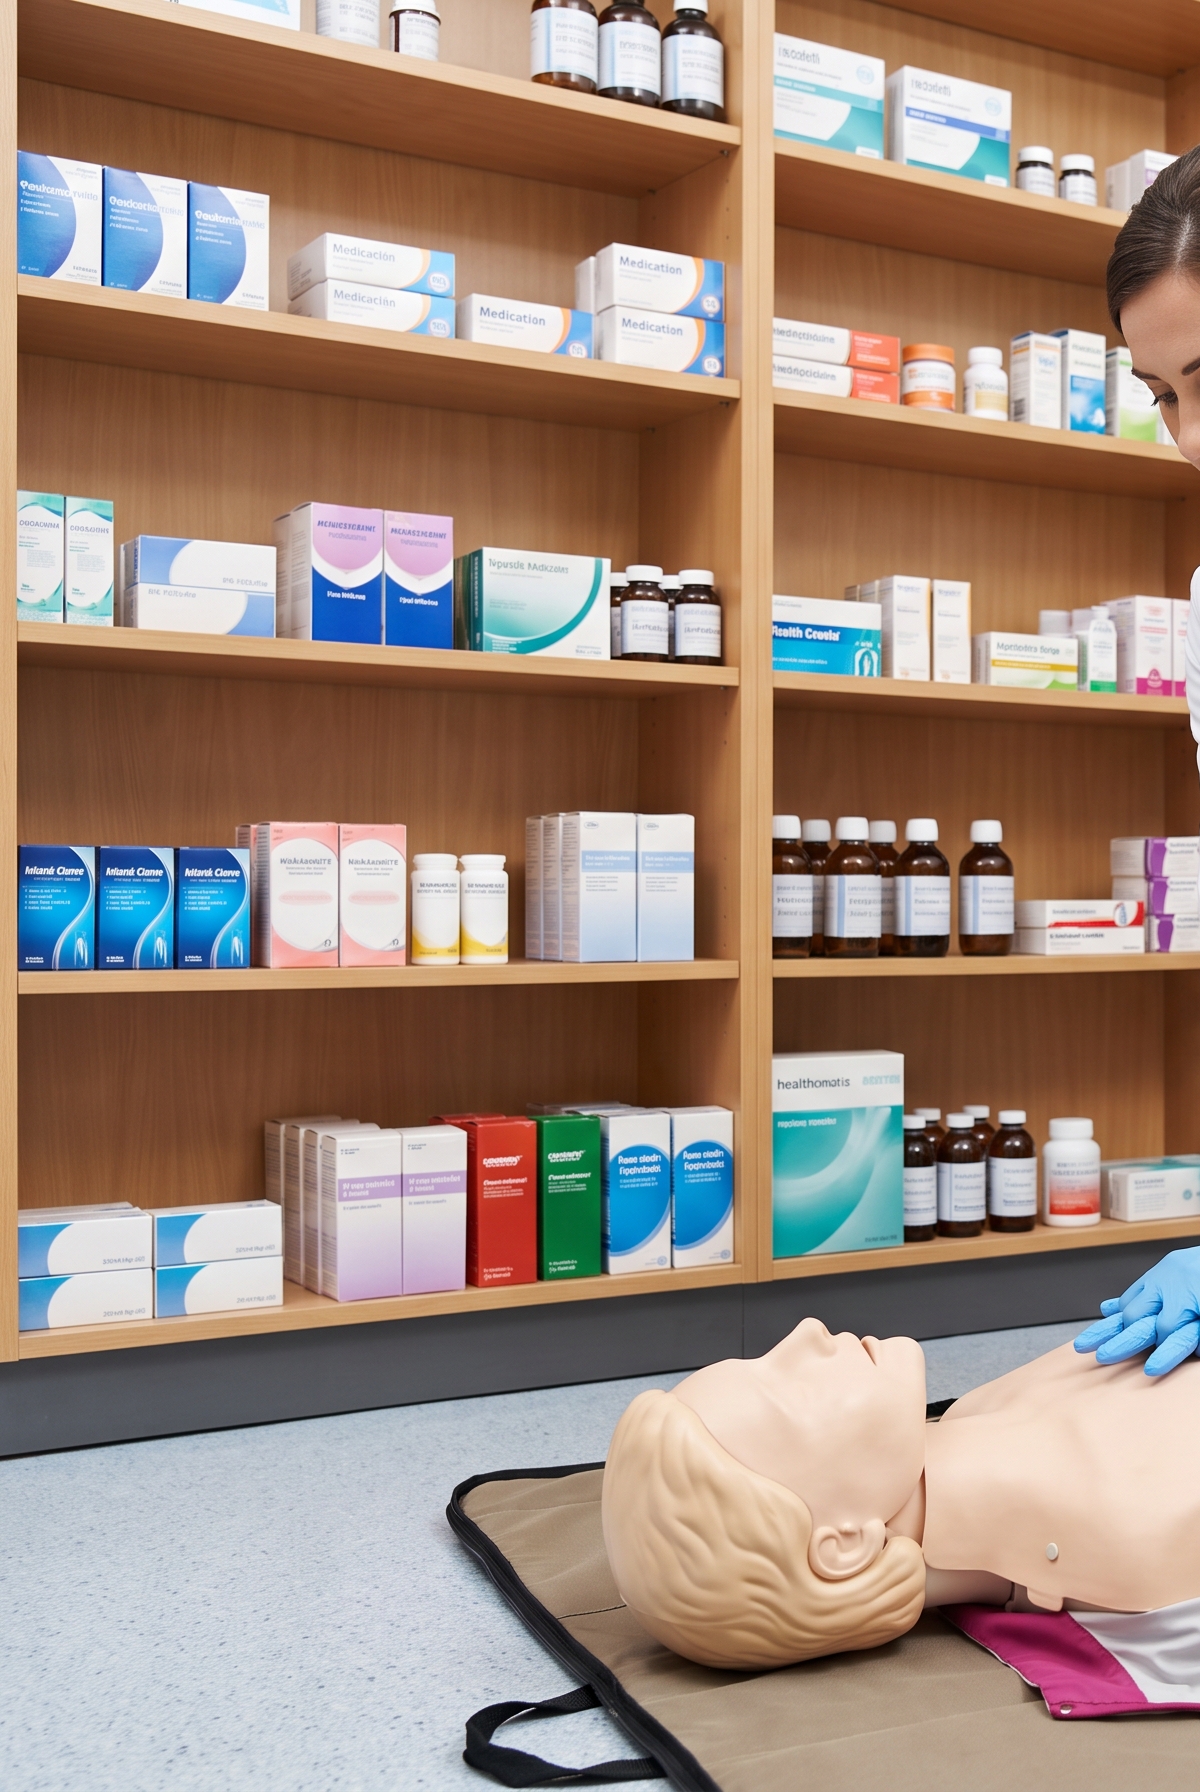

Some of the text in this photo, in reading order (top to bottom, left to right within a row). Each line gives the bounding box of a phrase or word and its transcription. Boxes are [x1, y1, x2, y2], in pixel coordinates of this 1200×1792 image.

[619, 255, 682, 275] Medication
[479, 306, 546, 326] Medication
[621, 318, 683, 336] Medication
[777, 1077, 850, 1090] healthomatis
